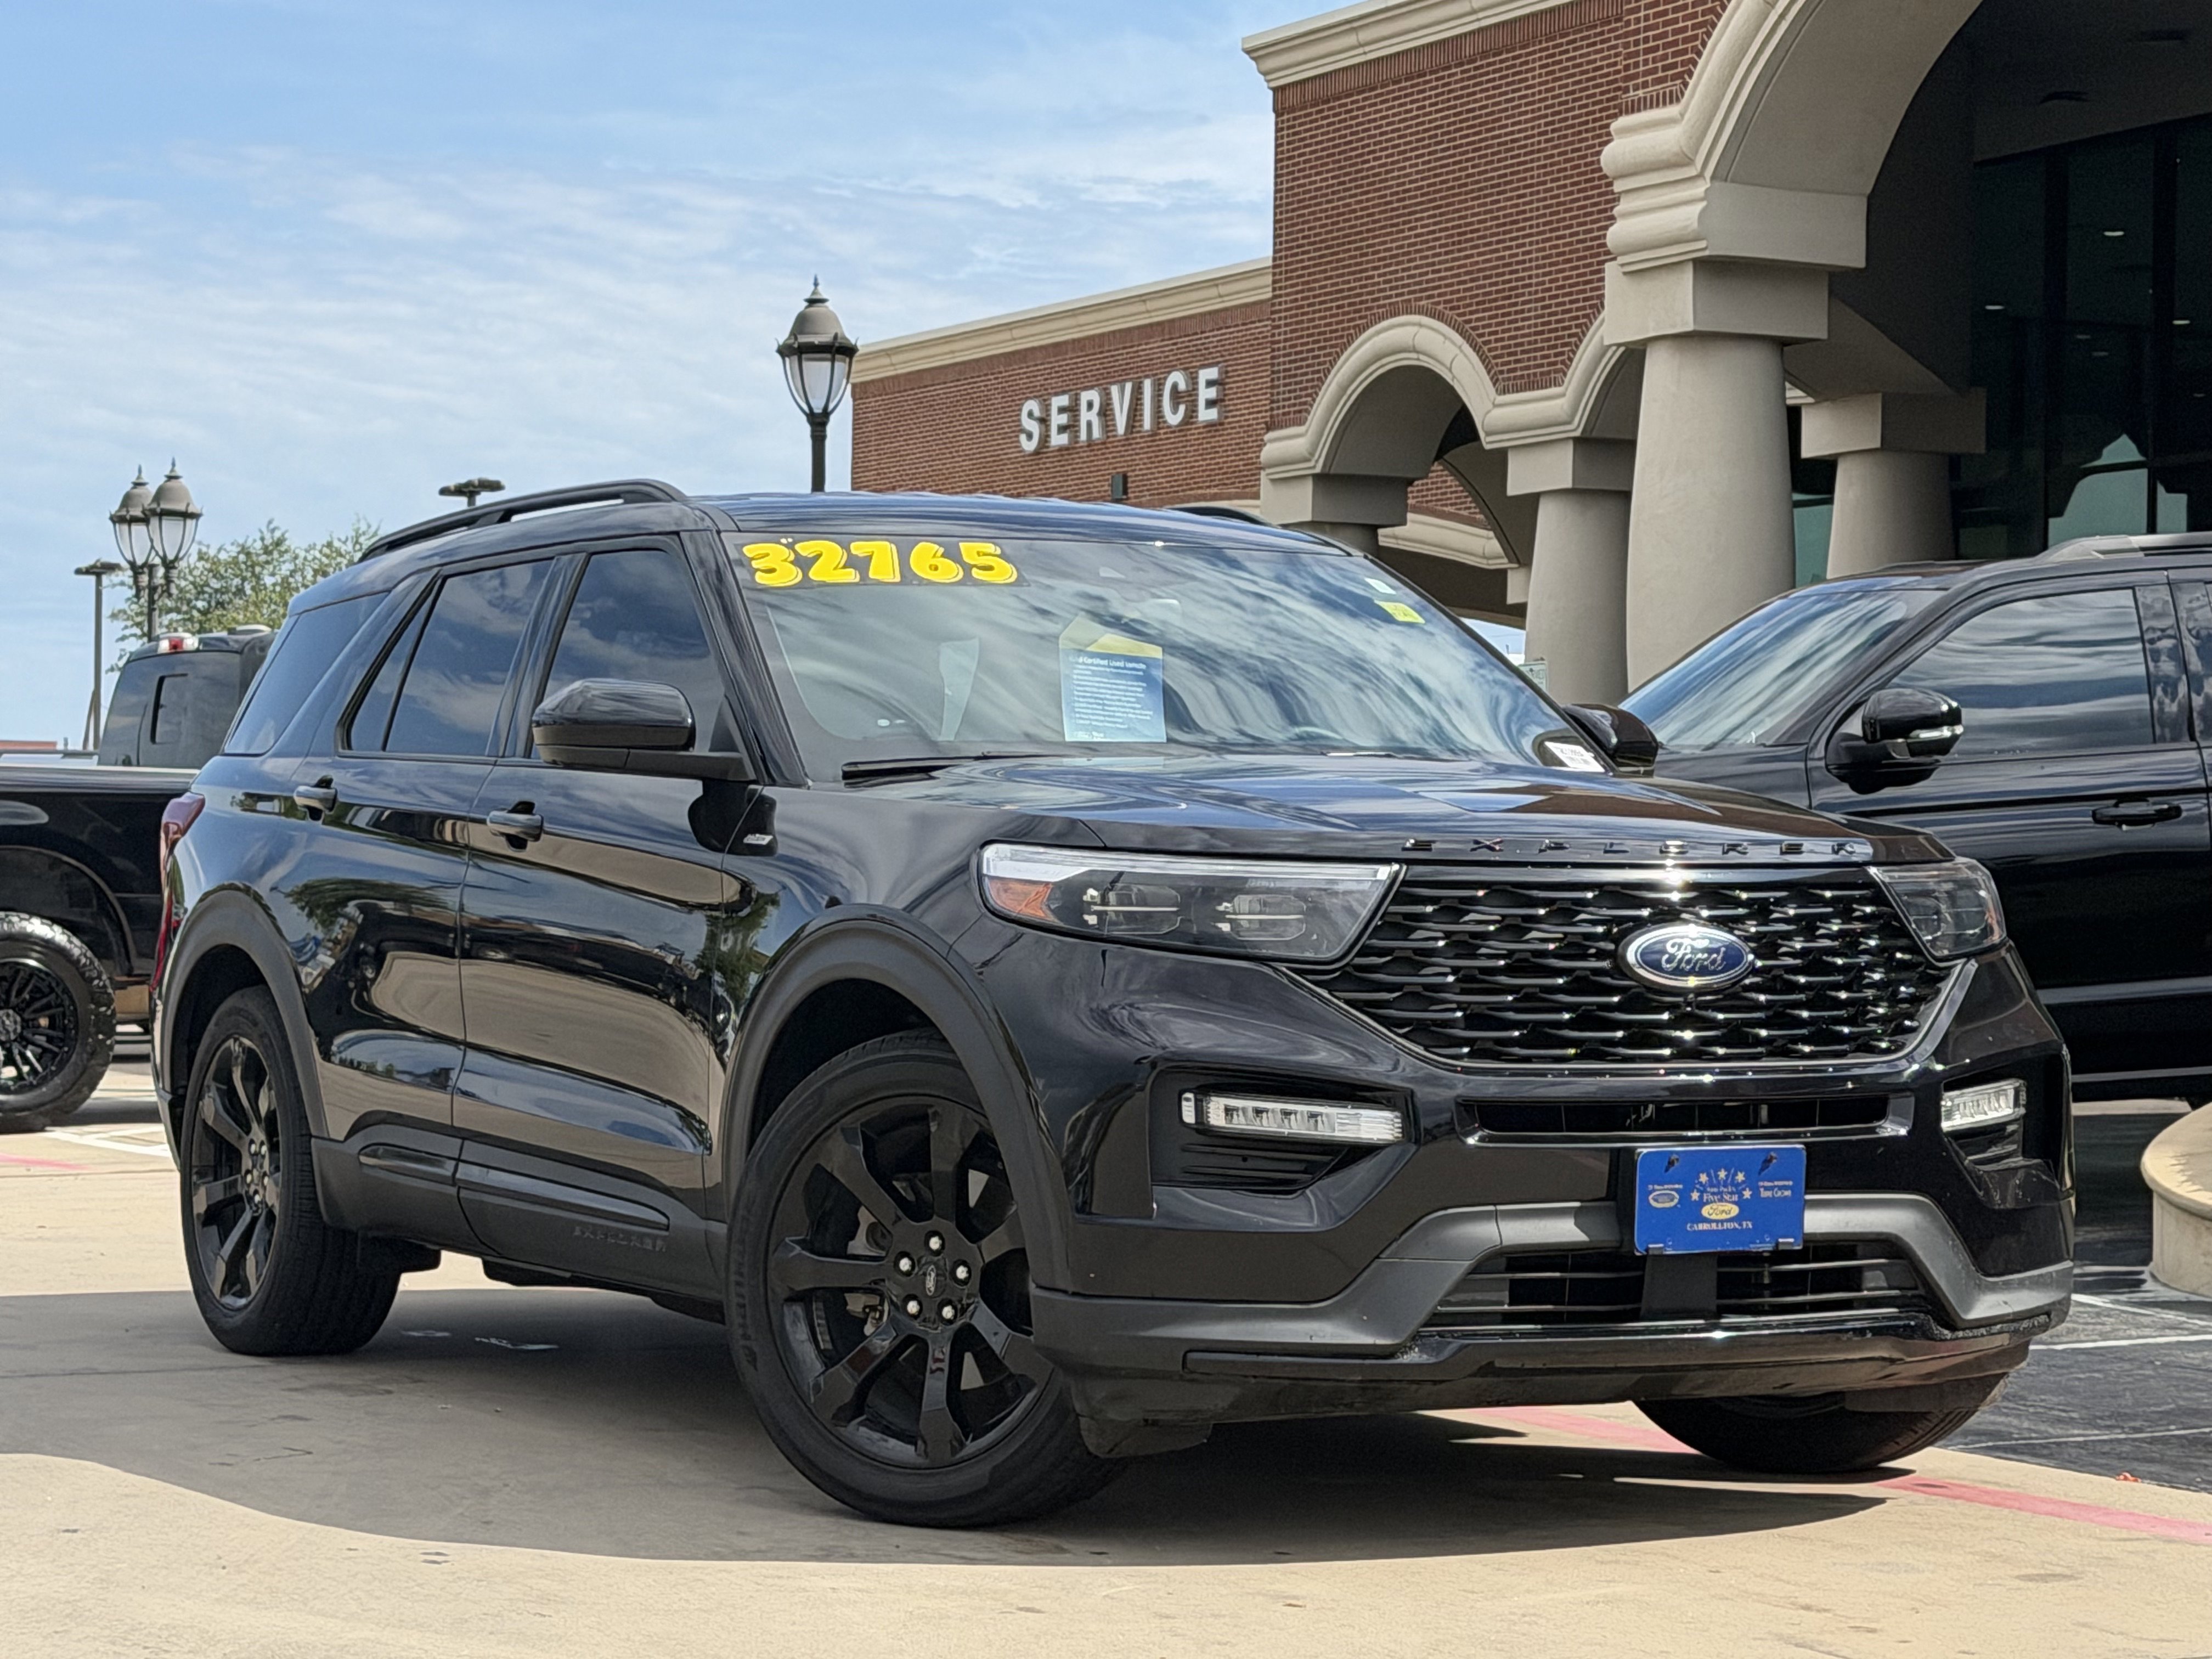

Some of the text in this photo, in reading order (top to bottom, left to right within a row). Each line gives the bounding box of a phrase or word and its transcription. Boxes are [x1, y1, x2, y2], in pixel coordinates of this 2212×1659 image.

[1019, 364, 1225, 454] SERVICE
[1401, 838, 1857, 855] EXPLORER
[1661, 938, 1726, 972] Ford
[1707, 1204, 1733, 1216] Ford
